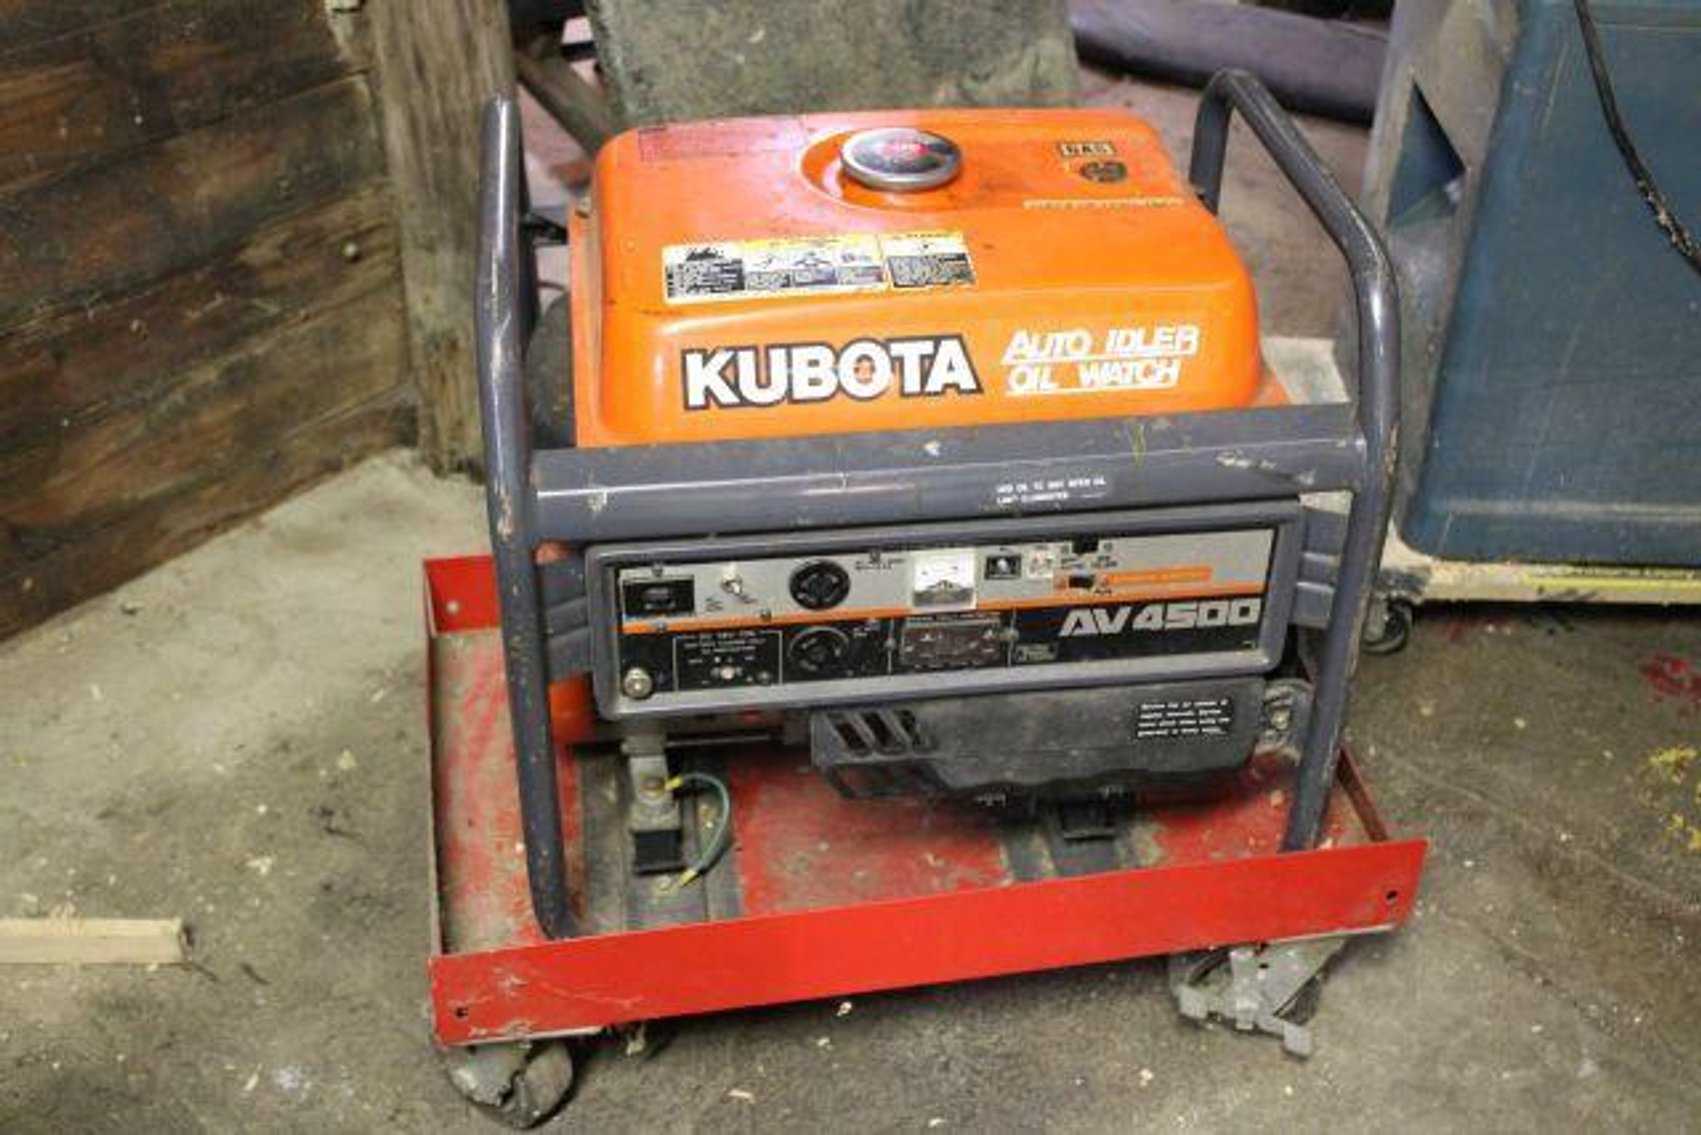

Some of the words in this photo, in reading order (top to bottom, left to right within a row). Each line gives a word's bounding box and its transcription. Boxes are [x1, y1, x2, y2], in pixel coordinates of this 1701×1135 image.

[1002, 329, 1093, 364] AUTO
[1105, 325, 1199, 355] IDLER
[684, 334, 981, 409] KUBOTA
[1007, 365, 1058, 392] OIL
[1079, 359, 1181, 388] WATCH
